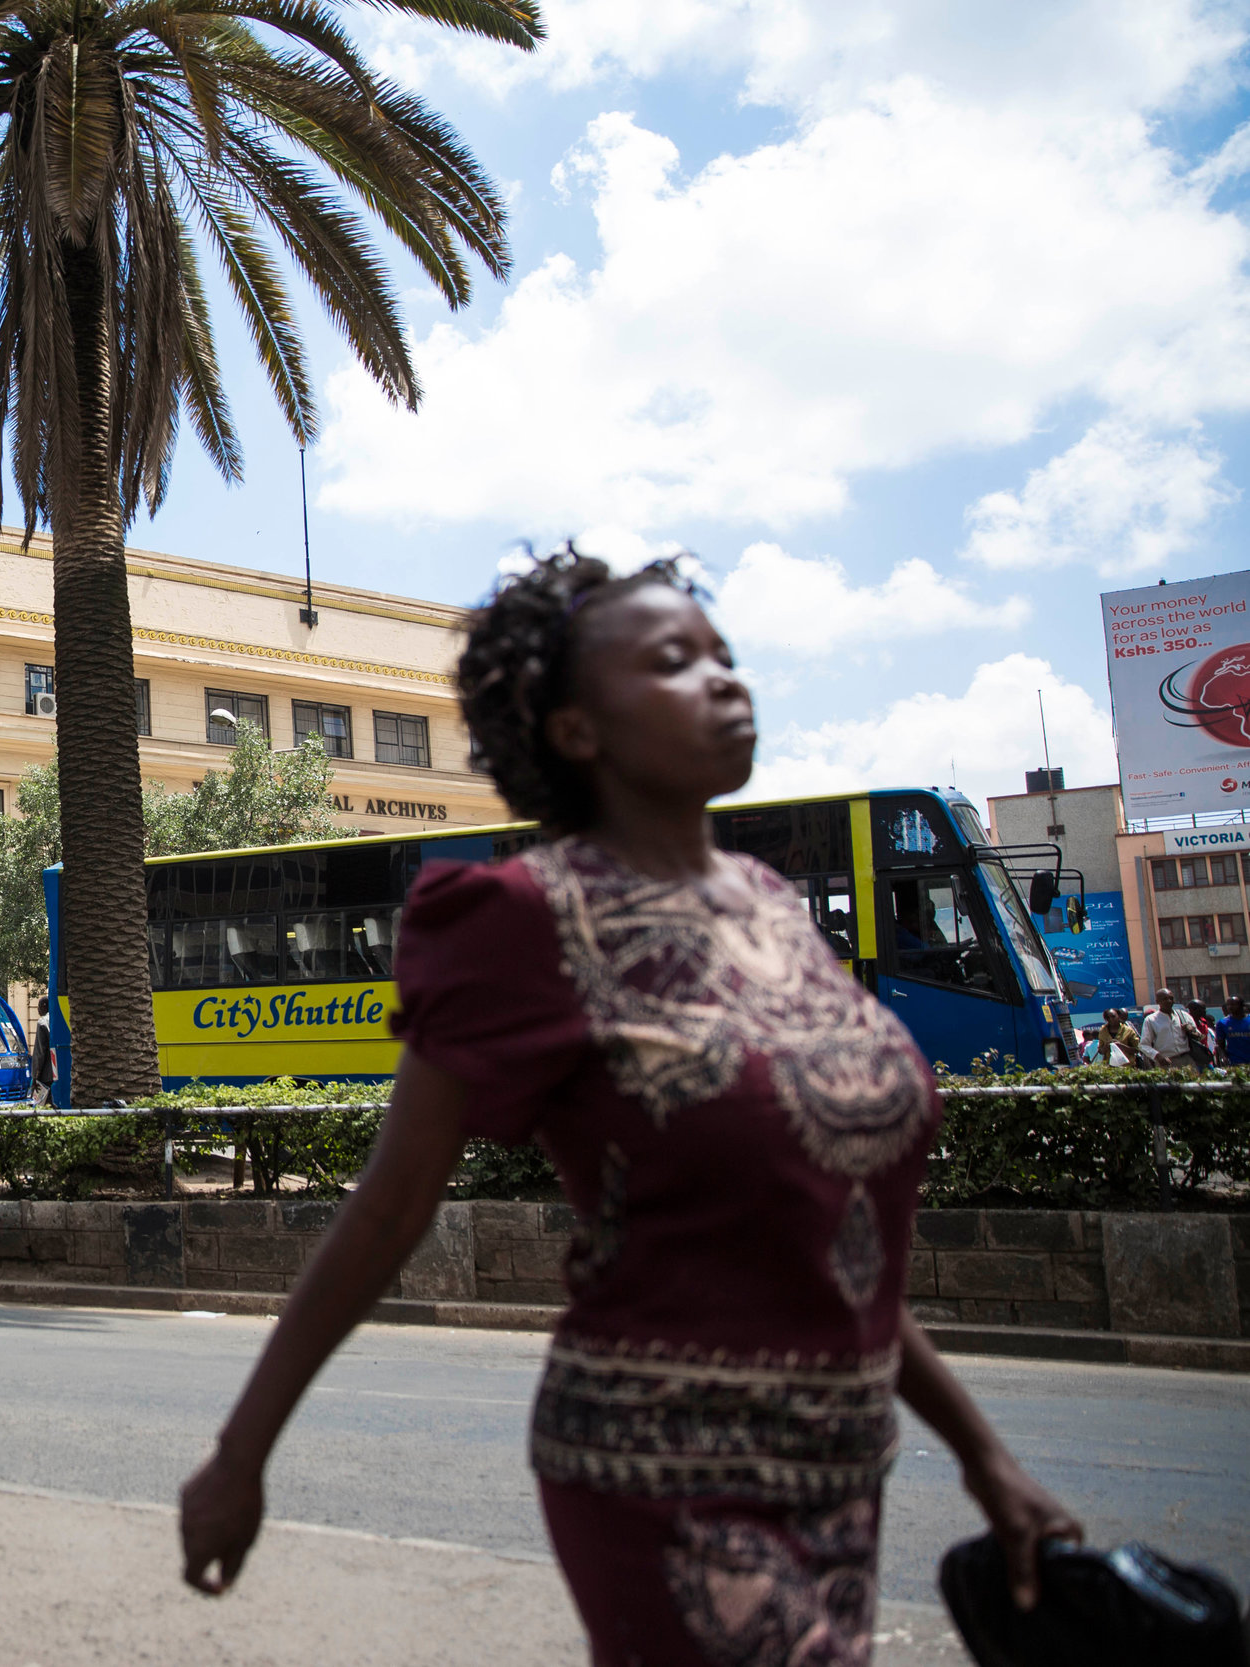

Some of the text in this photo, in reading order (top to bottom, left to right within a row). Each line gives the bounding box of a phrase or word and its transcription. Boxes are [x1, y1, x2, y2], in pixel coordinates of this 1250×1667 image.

[1110, 594, 1207, 617] Your money
[1111, 600, 1247, 631] across the world
[1113, 622, 1212, 645] for as low as
[1114, 637, 1213, 659] Kshs. 350...
[1128, 773, 1147, 781] Fast
[1153, 769, 1173, 778] Safe
[1179, 764, 1230, 776] Convenient
[365, 799, 448, 821] ARCHIVES
[1174, 832, 1245, 847] VICTORIA
